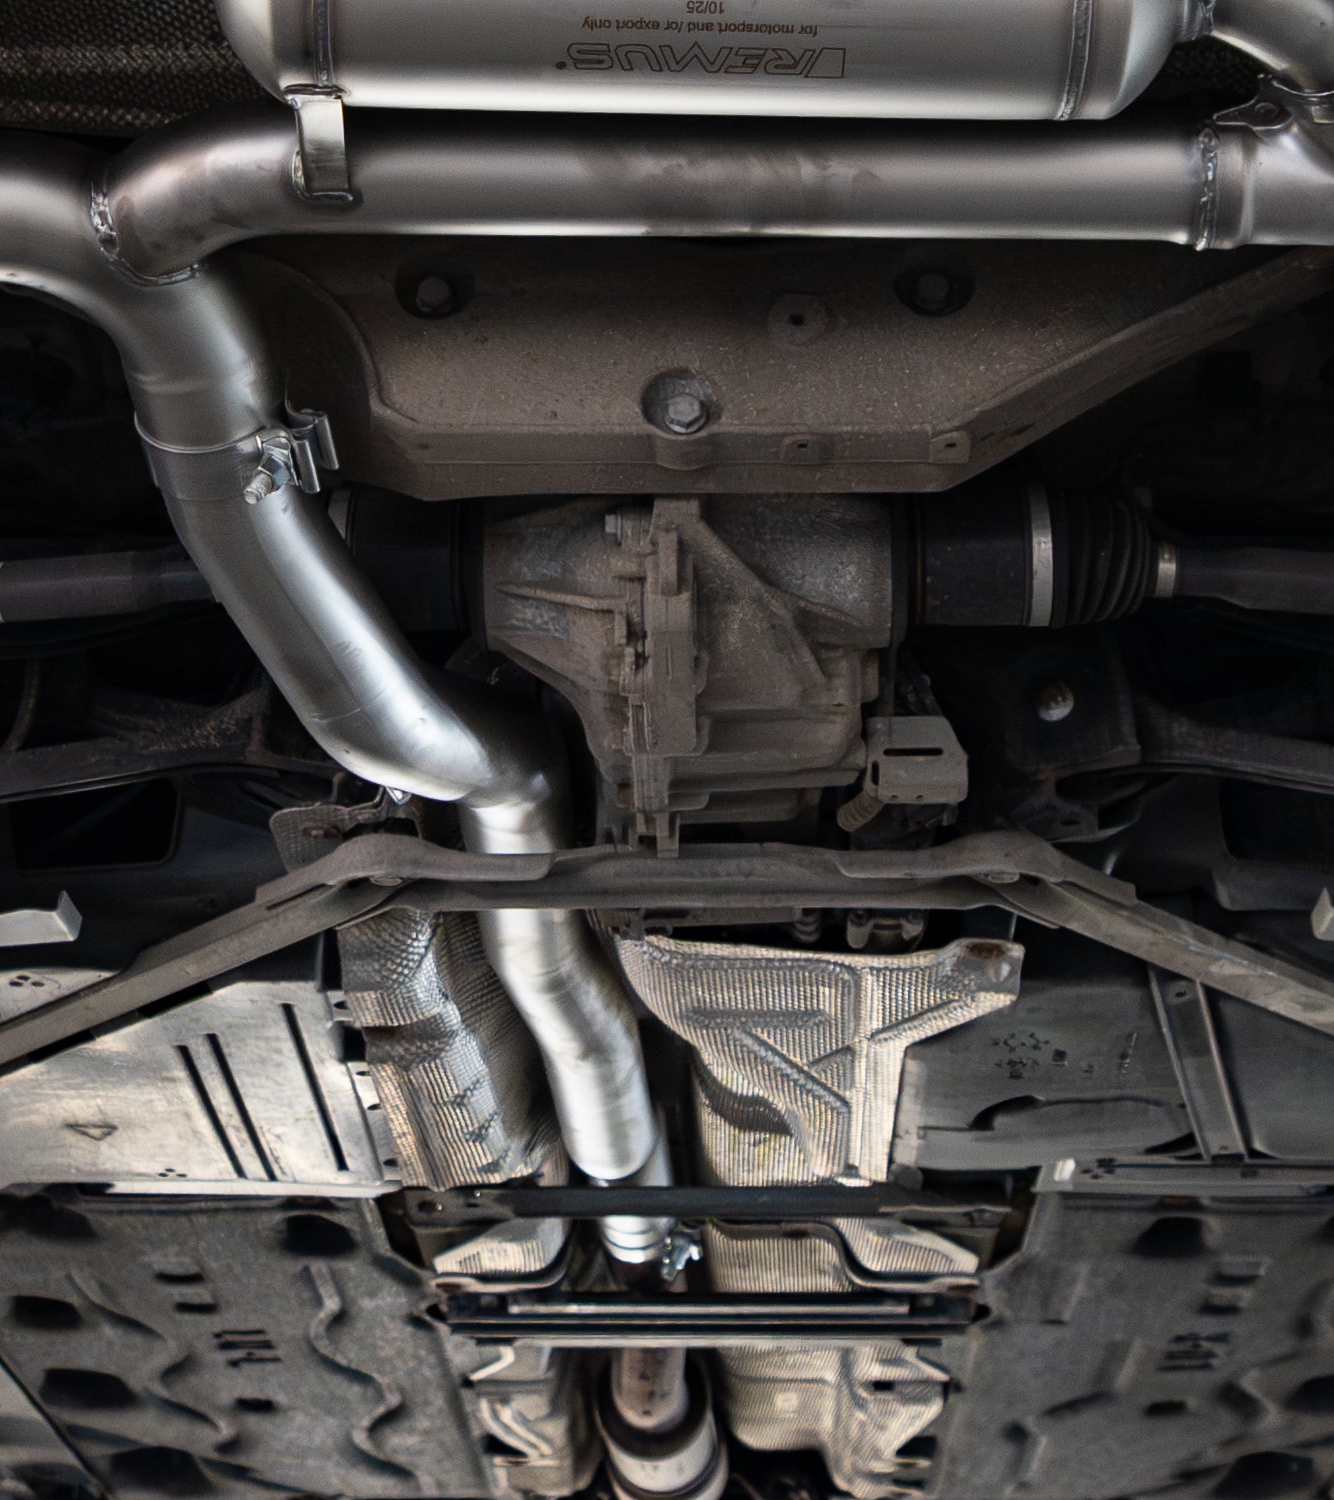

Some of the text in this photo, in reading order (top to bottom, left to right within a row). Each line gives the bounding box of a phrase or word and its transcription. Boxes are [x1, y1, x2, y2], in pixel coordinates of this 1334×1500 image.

[686, 0, 725, 14] 10/25
[582, 16, 818, 37] for motorsport and /or export only
[566, 40, 817, 76] REMUS
